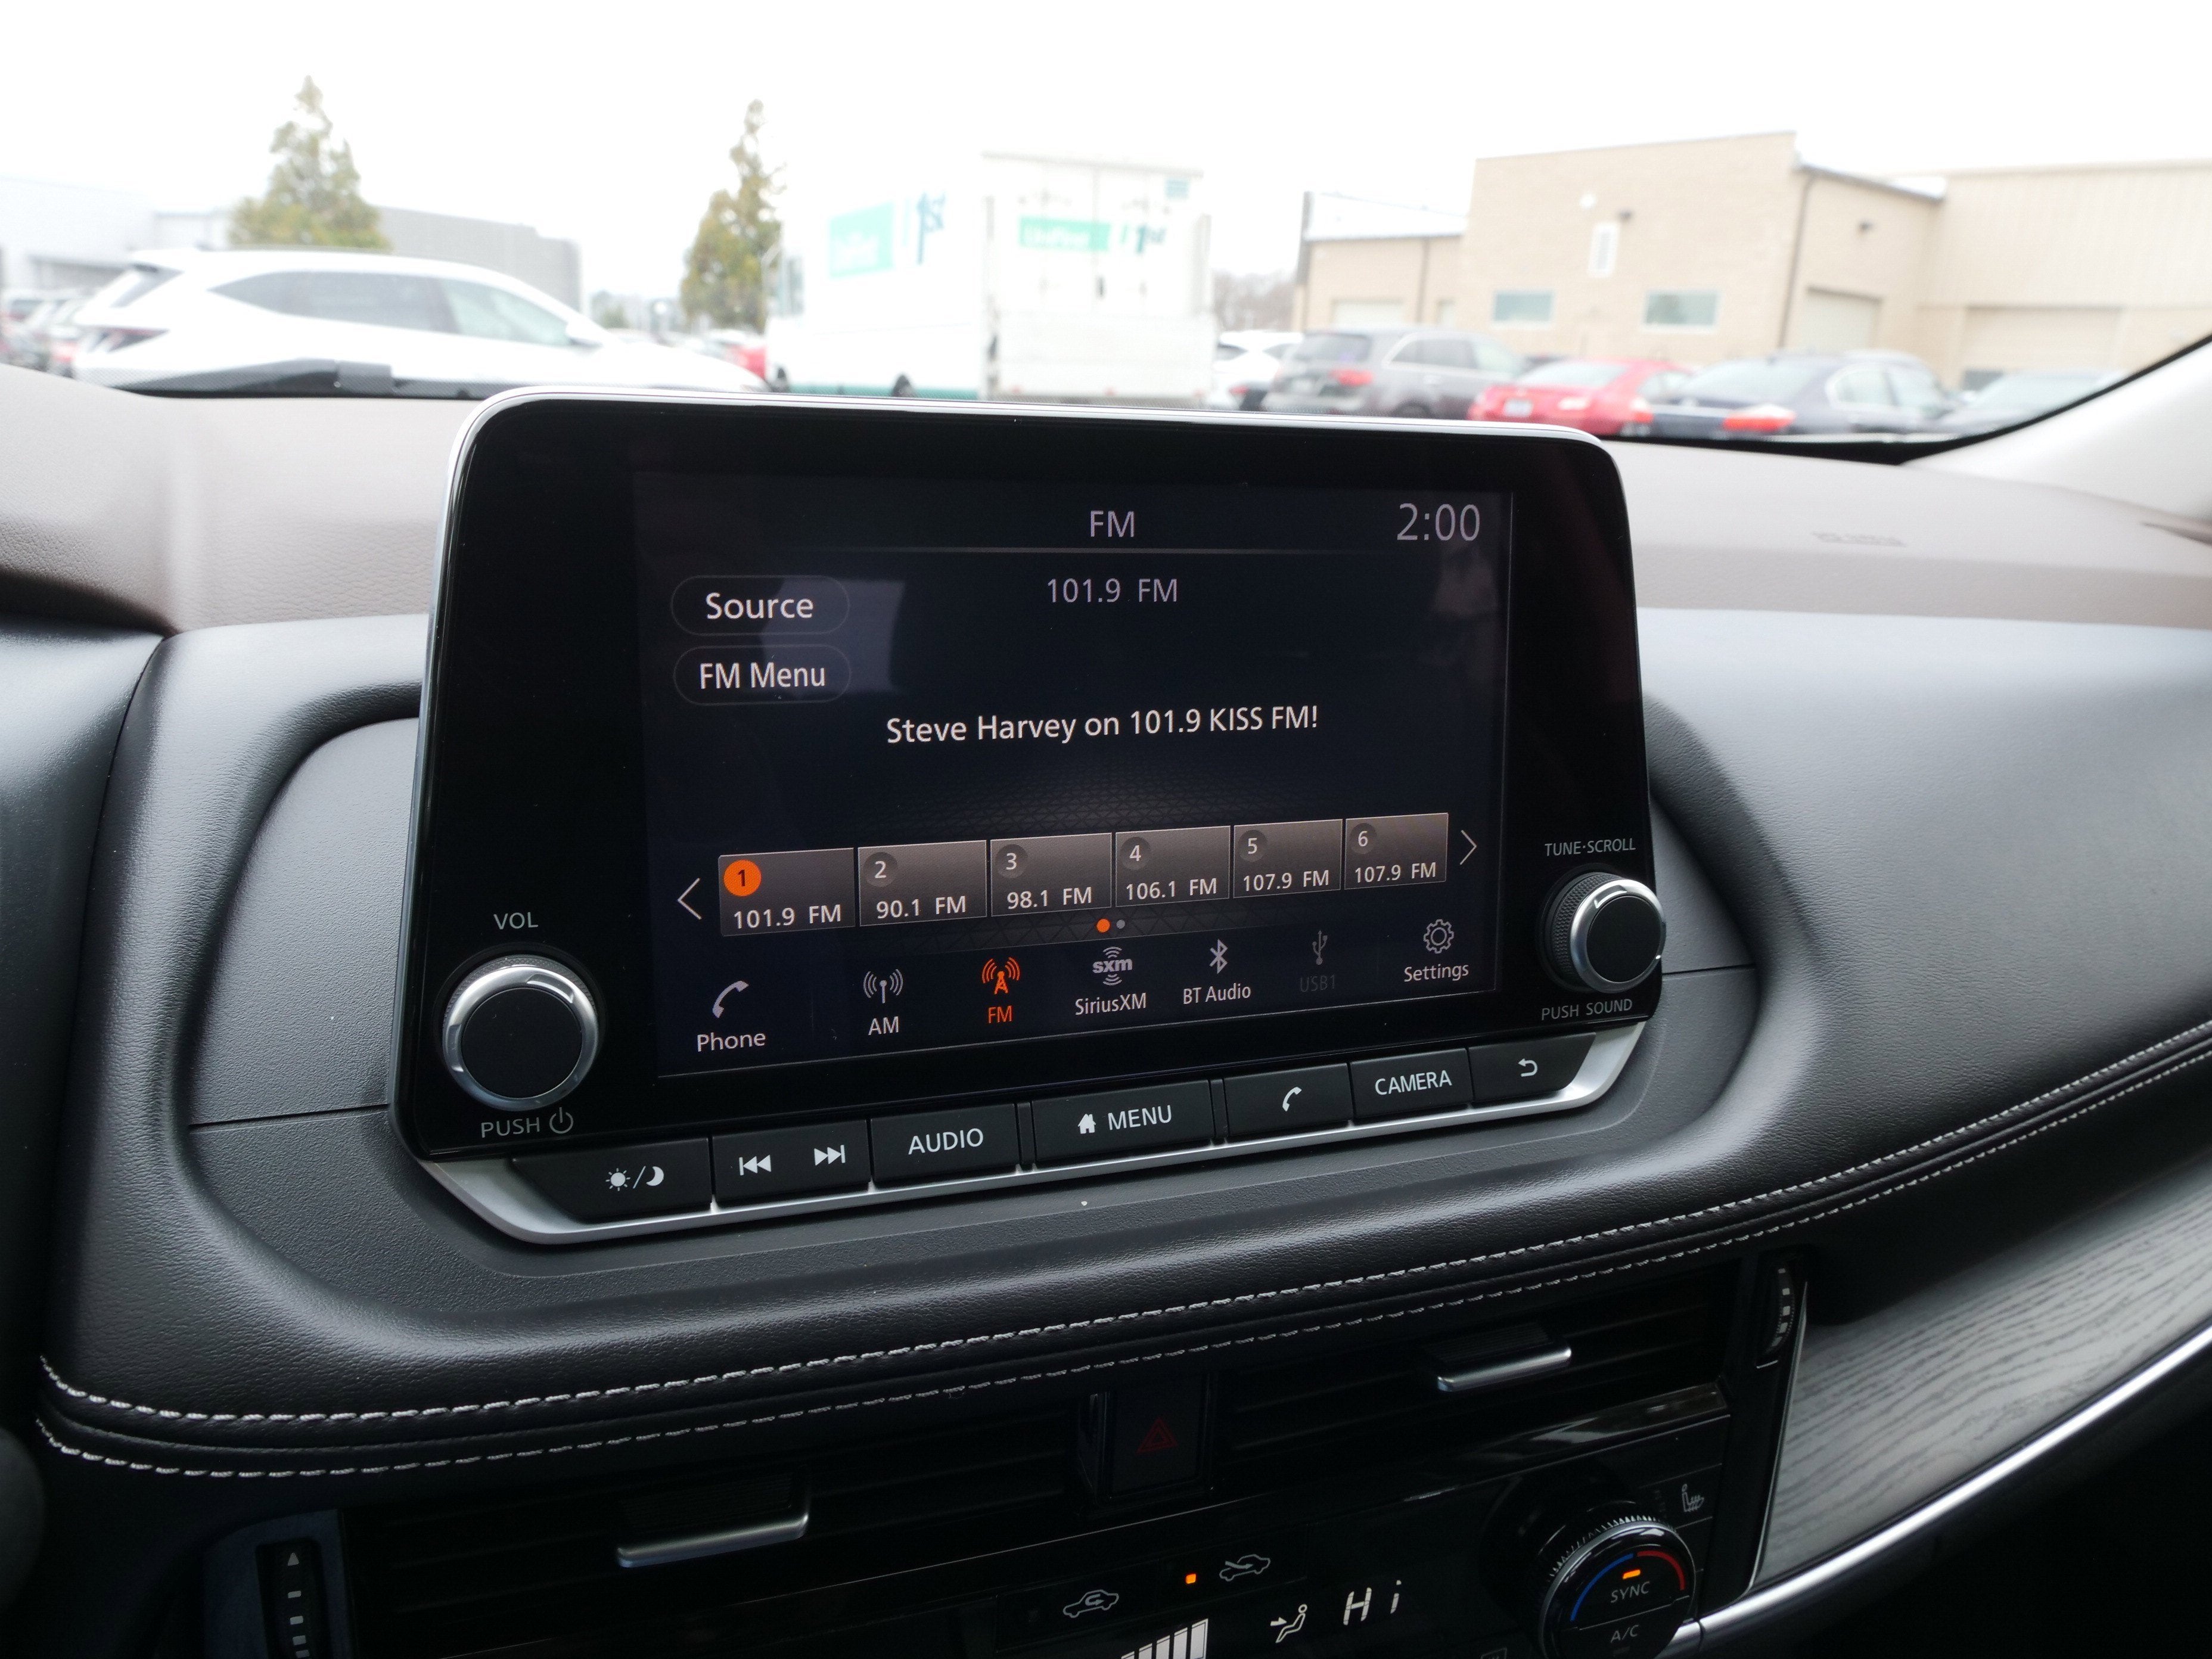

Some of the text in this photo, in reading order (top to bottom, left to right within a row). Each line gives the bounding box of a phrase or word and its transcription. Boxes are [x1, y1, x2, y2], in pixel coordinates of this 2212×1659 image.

[1090, 510, 1135, 538] FM
[1397, 502, 1480, 541] 2:00
[1048, 578, 1177, 603] 101.9 FM
[706, 592, 814, 619] Source
[700, 661, 825, 689] FM Menu
[887, 705, 1317, 744] Steve Harvey on 101.9 KISS FM!
[1248, 837, 1257, 855] 5
[1358, 830, 1368, 847] 6
[1006, 852, 1017, 870] 3
[1129, 845, 1142, 862] 4
[738, 869, 745, 887] 1
[874, 860, 887, 879] 2
[1243, 869, 1329, 891] 107.9 FM
[1355, 862, 1436, 883] 107.9 FM
[1006, 886, 1092, 909] 98.1 FM
[1126, 878, 1217, 900] 106.1 FM
[734, 904, 841, 929] 101.9 FM
[876, 895, 966, 919] 90.1 FM
[493, 912, 539, 930] VOL
[1092, 958, 1133, 974] sxm
[1404, 964, 1469, 982] Settings
[1183, 982, 1251, 1005] BT Audio
[1300, 974, 1335, 993] USB1
[988, 1005, 1012, 1024] FM
[1075, 992, 1147, 1015] SiriusXM
[1541, 998, 1633, 1021] PUSH SOUND
[868, 1016, 899, 1036] AM
[697, 1032, 766, 1052] Phone
[1375, 1070, 1452, 1095] CAMERA
[481, 1117, 540, 1138] PUSH
[1108, 1105, 1172, 1130] MENU
[908, 1127, 984, 1155] AUDIO
[1610, 1581, 1650, 1604] SYNC
[1610, 1624, 1639, 1644] A/C
